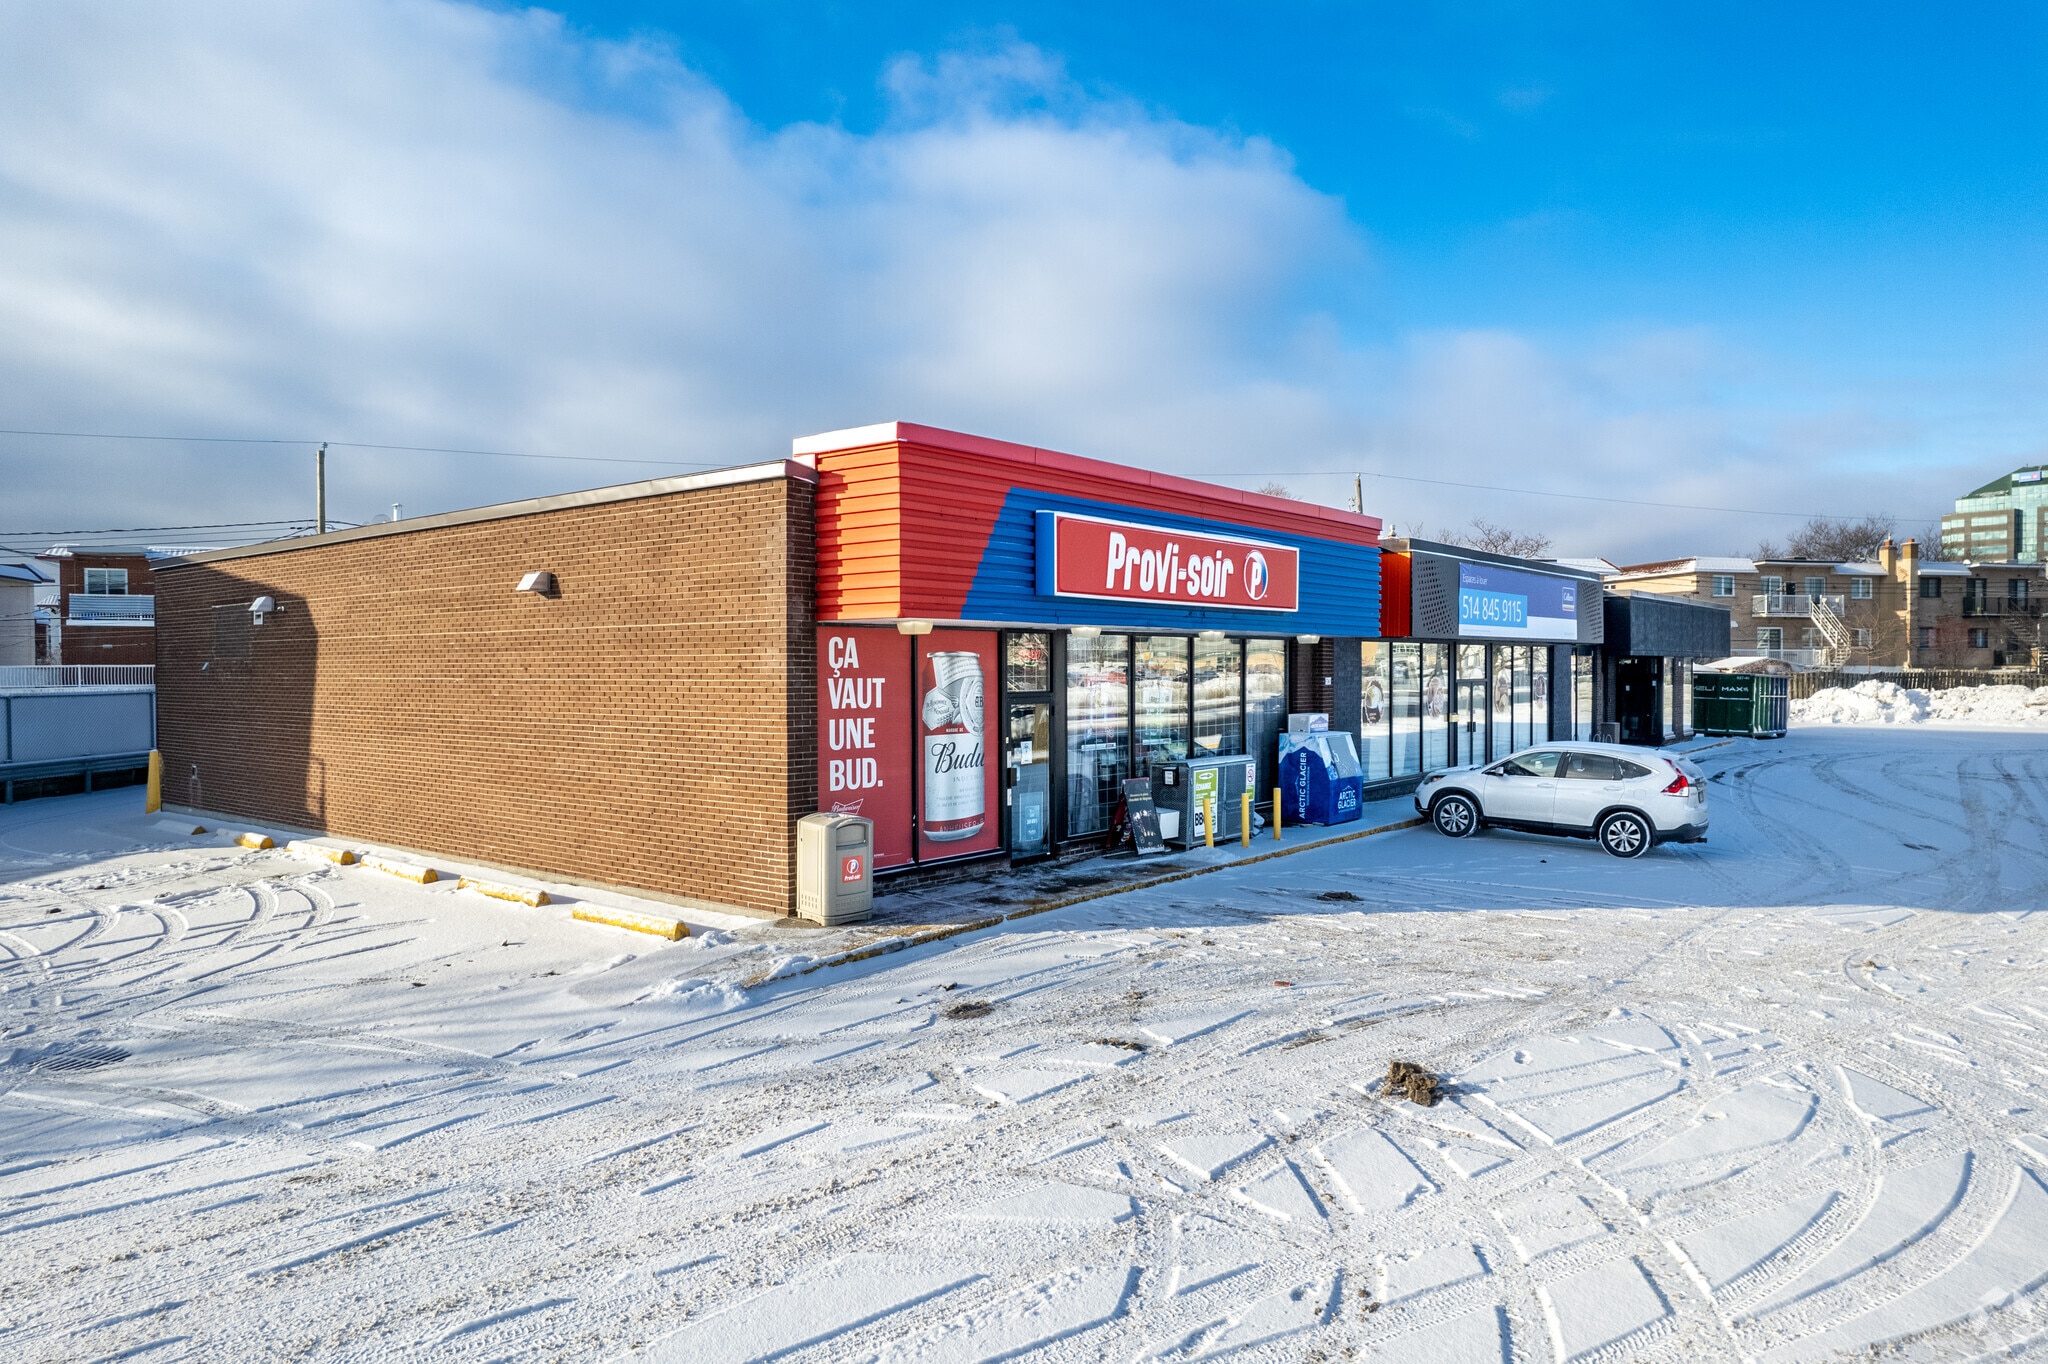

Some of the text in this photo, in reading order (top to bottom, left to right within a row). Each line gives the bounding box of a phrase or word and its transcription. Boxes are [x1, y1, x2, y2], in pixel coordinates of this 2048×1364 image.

[1106, 532, 1233, 597] Provi-soir
[1462, 574, 1476, 584] Espaces
[1462, 595, 1522, 622] 514 845 9115
[828, 637, 860, 678] ÇA
[827, 678, 886, 710] VAUT
[829, 718, 876, 751] UNE
[829, 757, 884, 792] BUD.
[1299, 752, 1307, 787] GLACIER
[1337, 798, 1356, 809] GLACIER
[1339, 790, 1356, 800] ARCTIC
